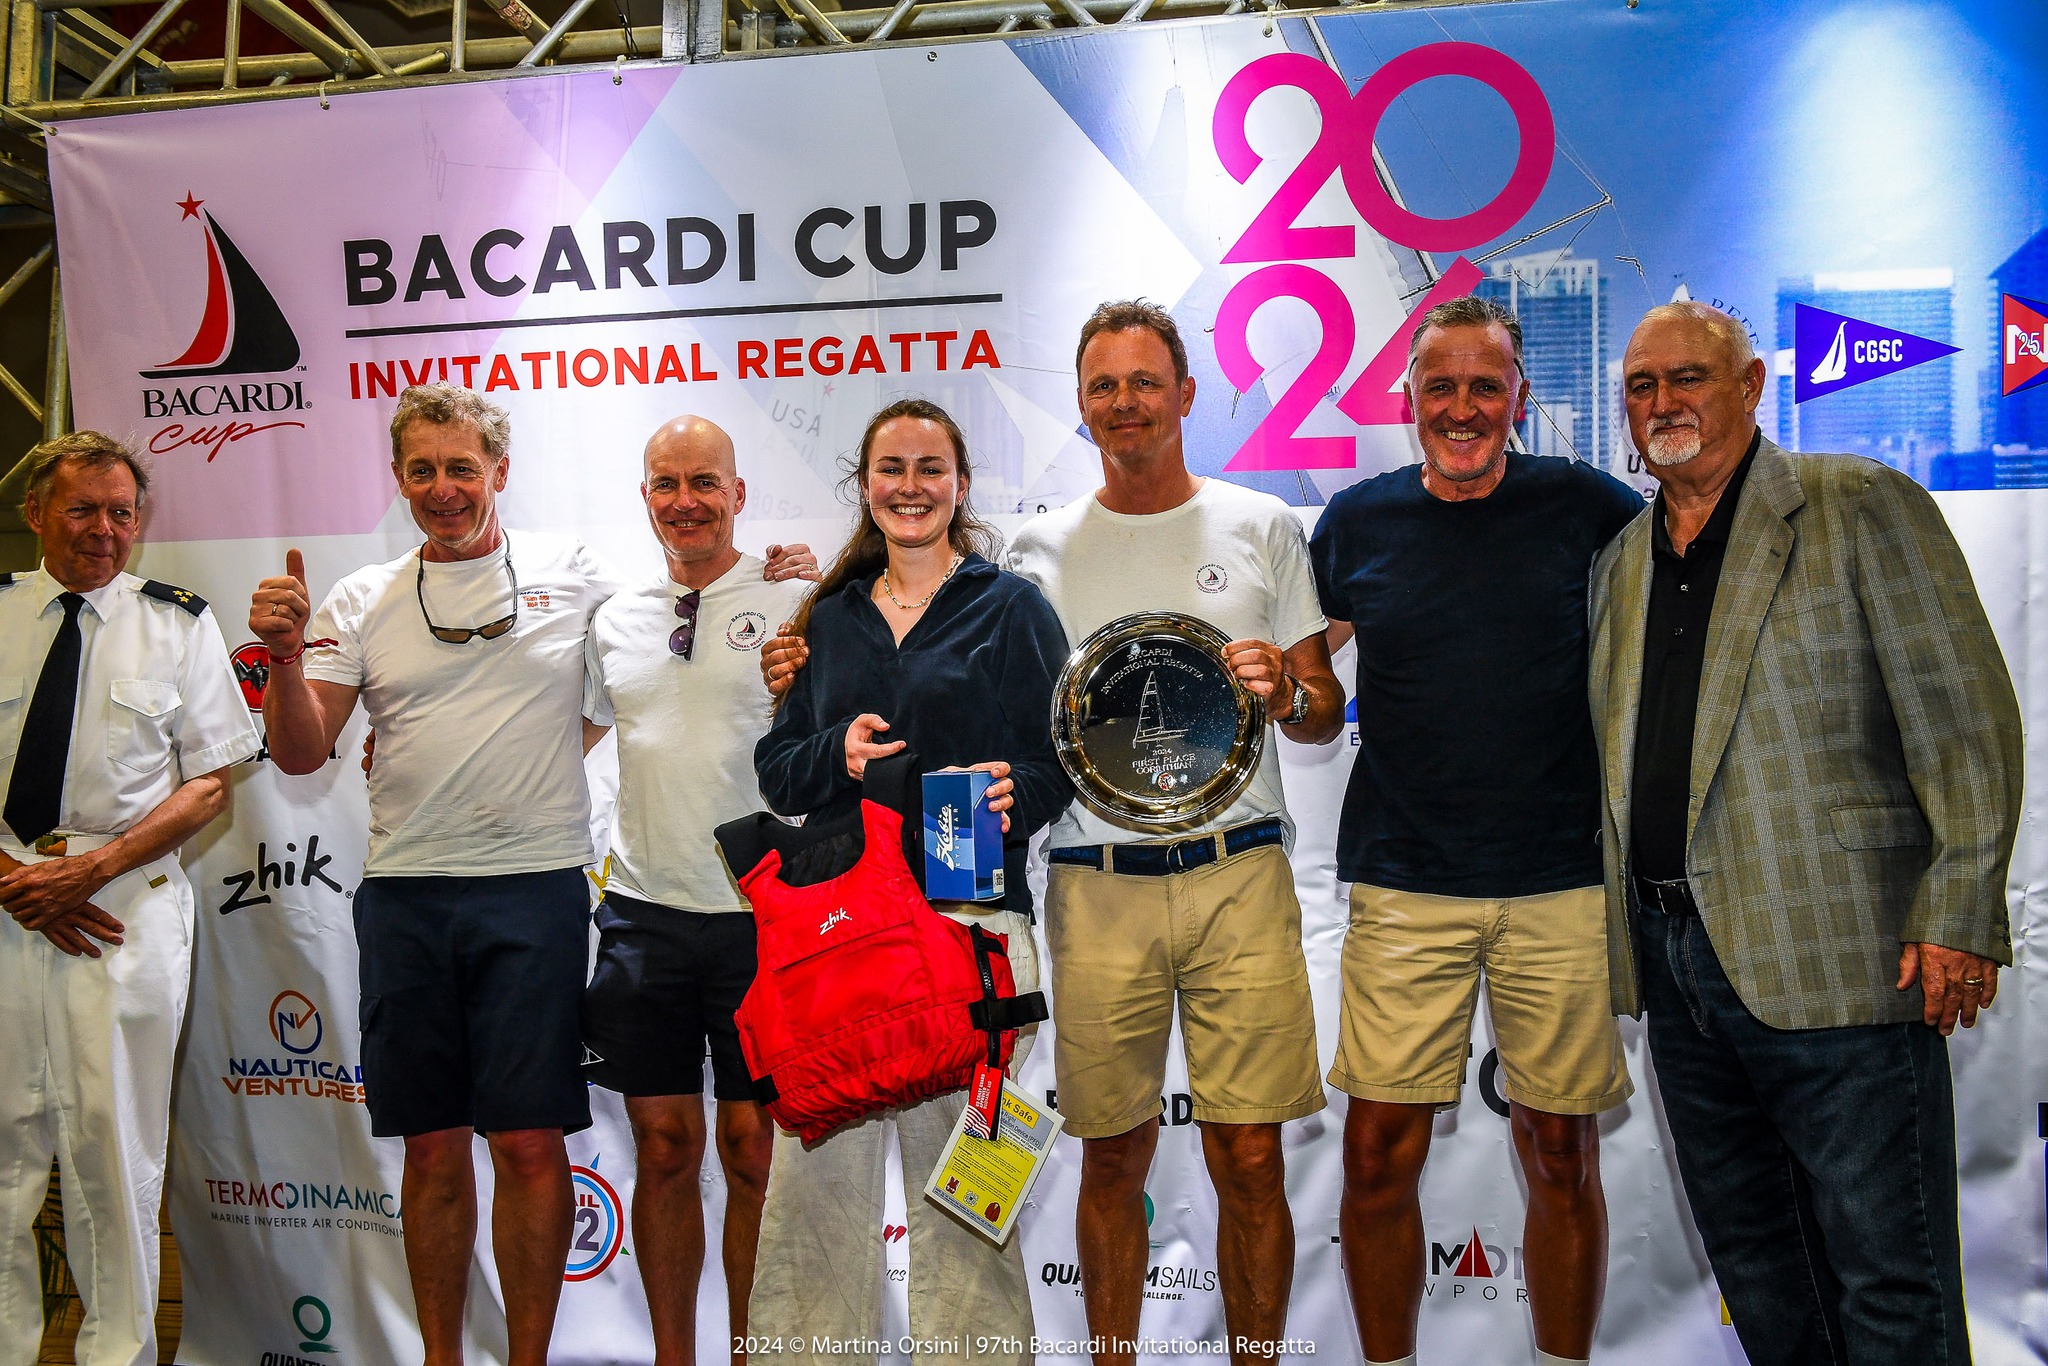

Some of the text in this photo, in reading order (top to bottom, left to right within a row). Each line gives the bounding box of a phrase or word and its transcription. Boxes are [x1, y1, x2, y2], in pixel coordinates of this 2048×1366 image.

[343, 199, 998, 306] BACARDI CUP
[350, 329, 1002, 400] INVITATIONAL REGATTA
[1854, 338, 1904, 364] CGSC
[142, 381, 305, 418] BACARDI
[772, 399, 821, 437] USA
[731, 611, 766, 623] BACARDI CUP
[1132, 753, 1196, 768] FIRST PLACE
[1136, 761, 1192, 774] CORINTHIAN
[935, 804, 955, 871] Hobie
[953, 808, 961, 868] EYEWEAR
[219, 835, 343, 915] zhik
[820, 908, 851, 935] zhik
[229, 1057, 363, 1084] NAUTICAL
[221, 1076, 366, 1103] VENTURES
[1013, 1104, 1033, 1122] Safe
[205, 1179, 402, 1219] TERMODINAMIC
[211, 1212, 250, 1226] MARINE
[254, 1217, 307, 1229] INVERTER
[312, 1218, 332, 1229] AIR
[1143, 1291, 1186, 1301] HALLENGE.
